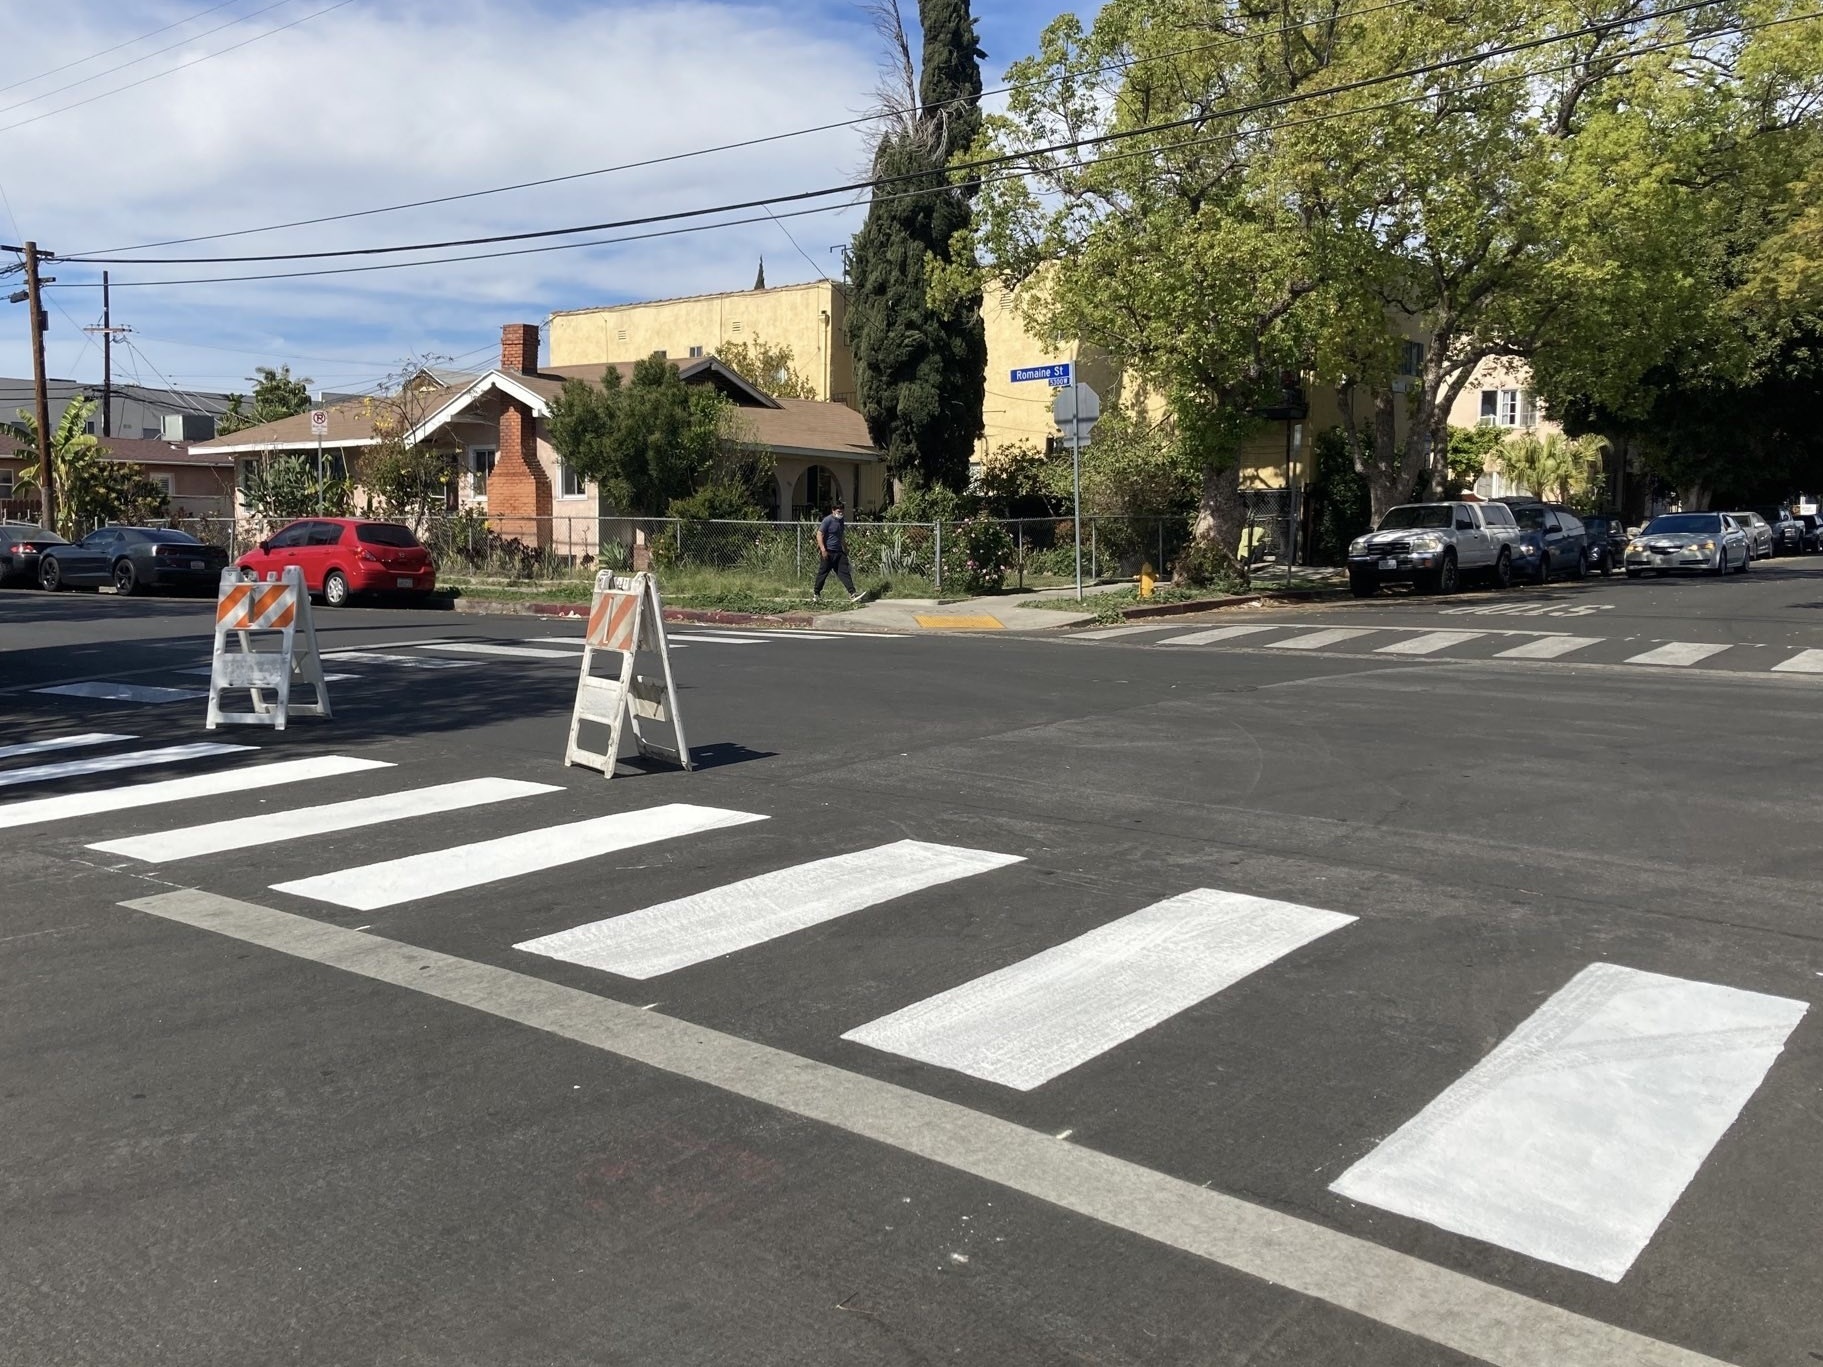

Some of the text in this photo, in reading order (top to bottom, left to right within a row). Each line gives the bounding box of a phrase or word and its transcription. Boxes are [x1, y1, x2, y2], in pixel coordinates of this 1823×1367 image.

[1016, 366, 1063, 380] Romaine St
[1438, 603, 1616, 617] STOP
